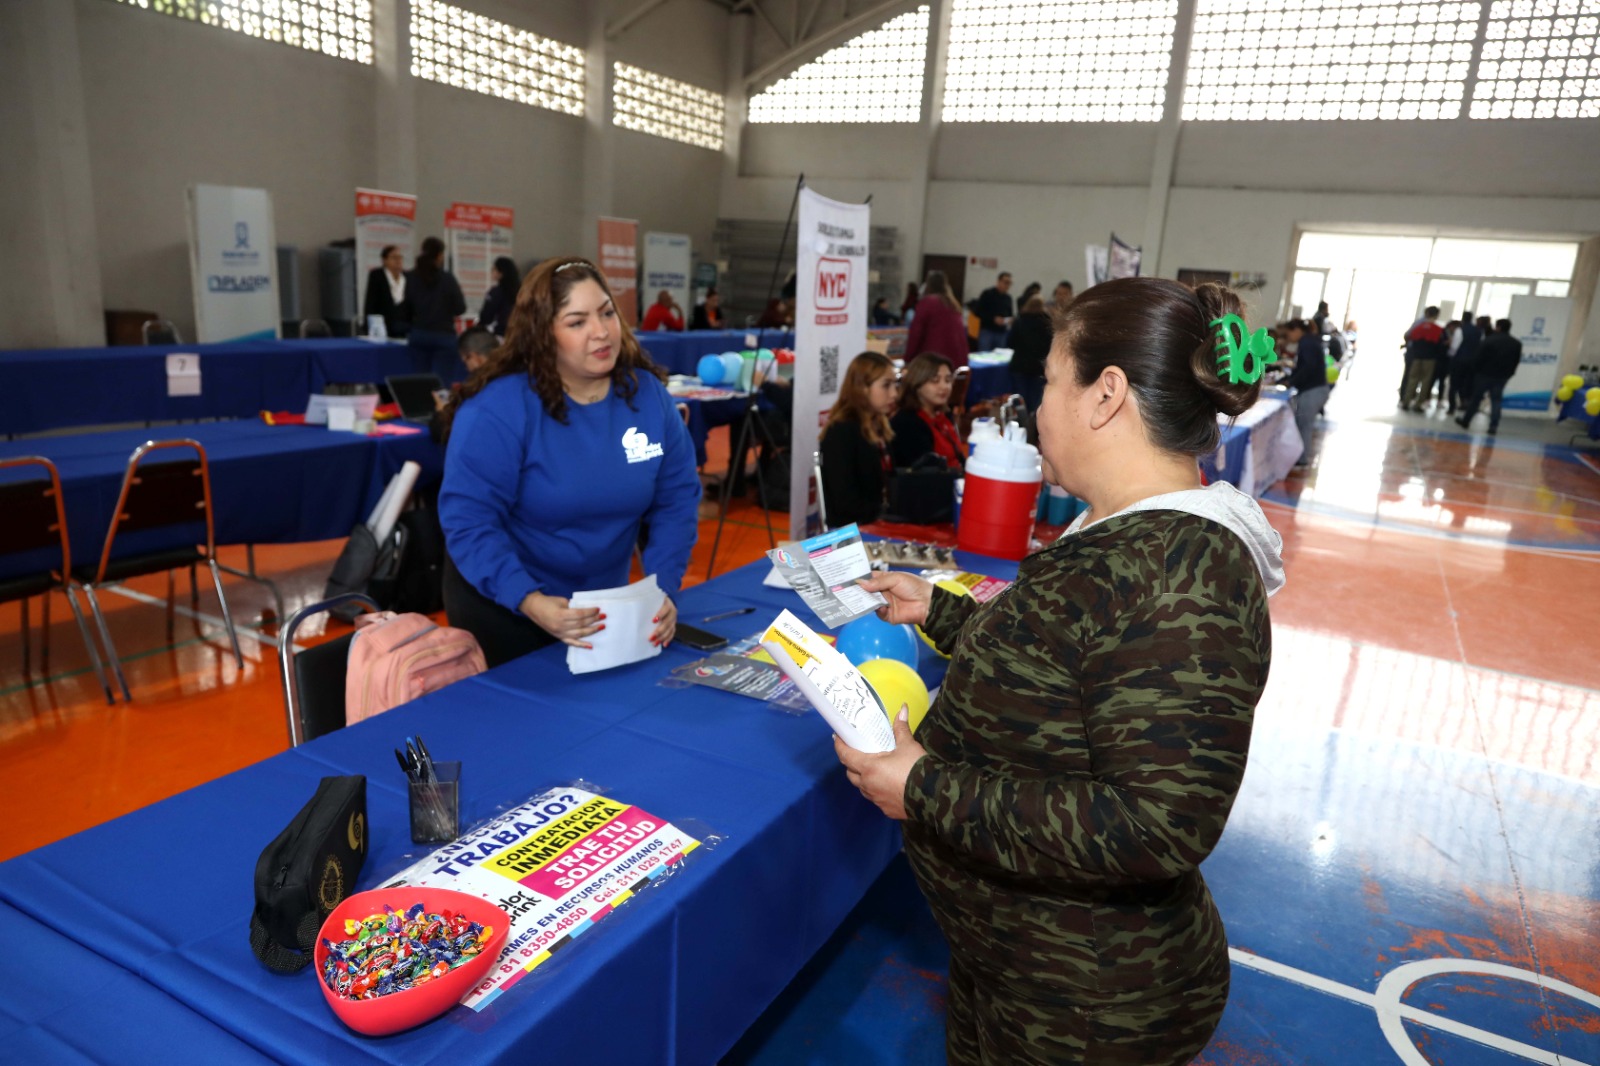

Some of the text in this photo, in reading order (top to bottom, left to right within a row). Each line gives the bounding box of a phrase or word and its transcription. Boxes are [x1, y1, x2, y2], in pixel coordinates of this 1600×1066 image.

[818, 271, 847, 299] NYC
[433, 794, 580, 876] TRABAJO?
[496, 799, 606, 867] CONTRATACIÓN
[510, 806, 621, 874] INMEDIATA
[545, 820, 628, 875] TRAE TU
[553, 820, 656, 889] SOLICITUD
[469, 975, 502, 997] Tel.
[499, 957, 521, 974] 81
[519, 907, 588, 957] 8350-4850
[593, 885, 620, 903] Cel.
[638, 855, 661, 872] 029
[659, 838, 684, 857] 1747
[496, 838, 664, 964] ORMES EN RECURSOS HUMANOS
[497, 890, 526, 912] olor
